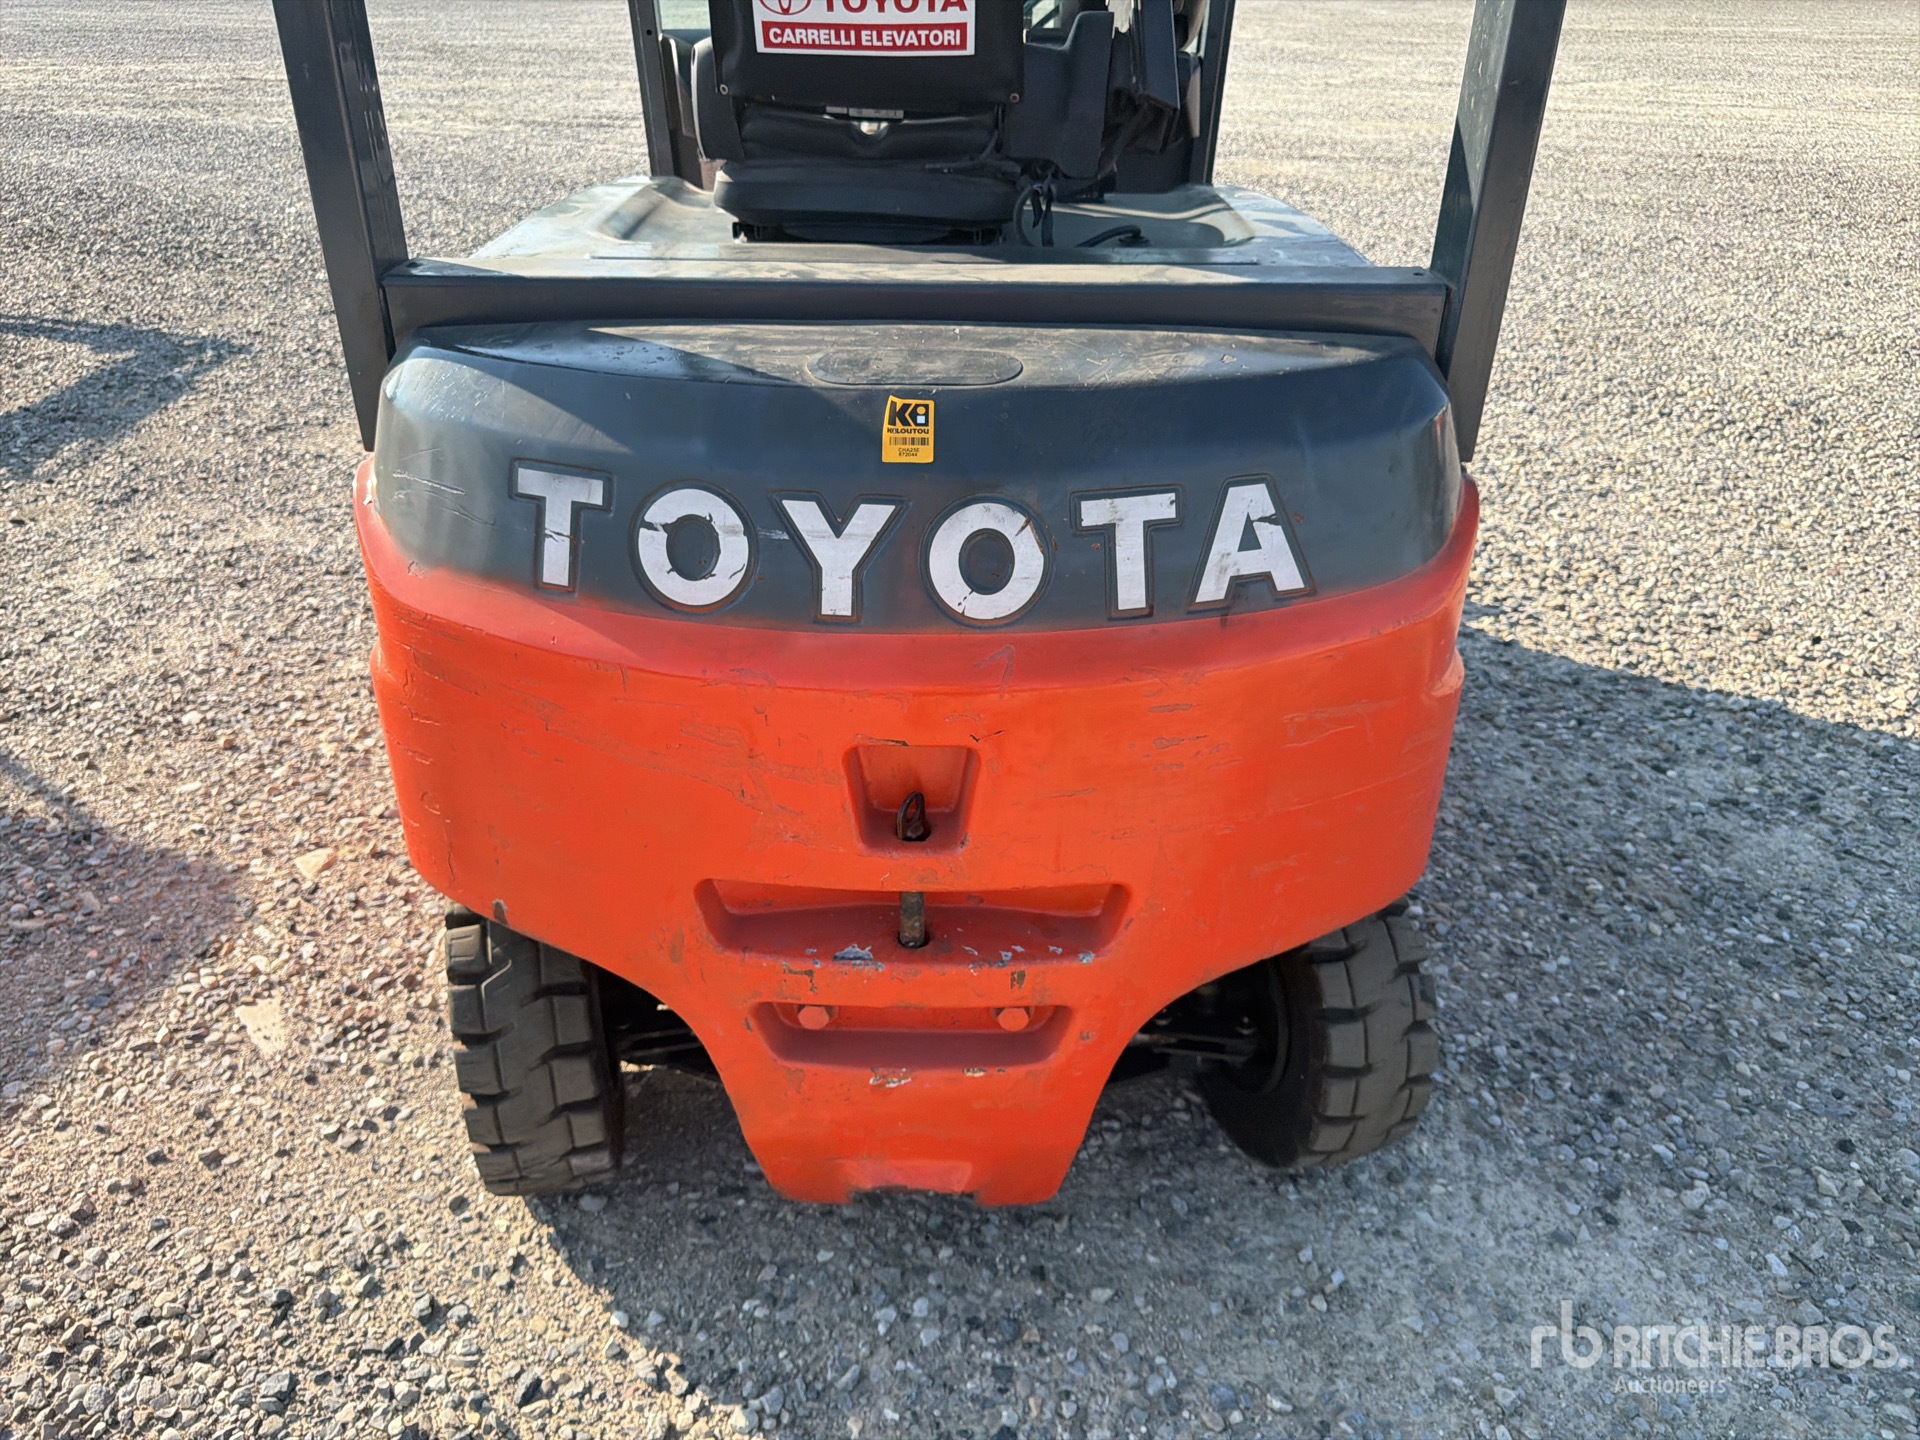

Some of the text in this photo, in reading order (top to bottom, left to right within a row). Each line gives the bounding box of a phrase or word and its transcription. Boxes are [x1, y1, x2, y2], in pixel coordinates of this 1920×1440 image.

[768, 27, 961, 46] CARRELLI ELEVATORI
[516, 466, 1305, 621] TOYOTA
